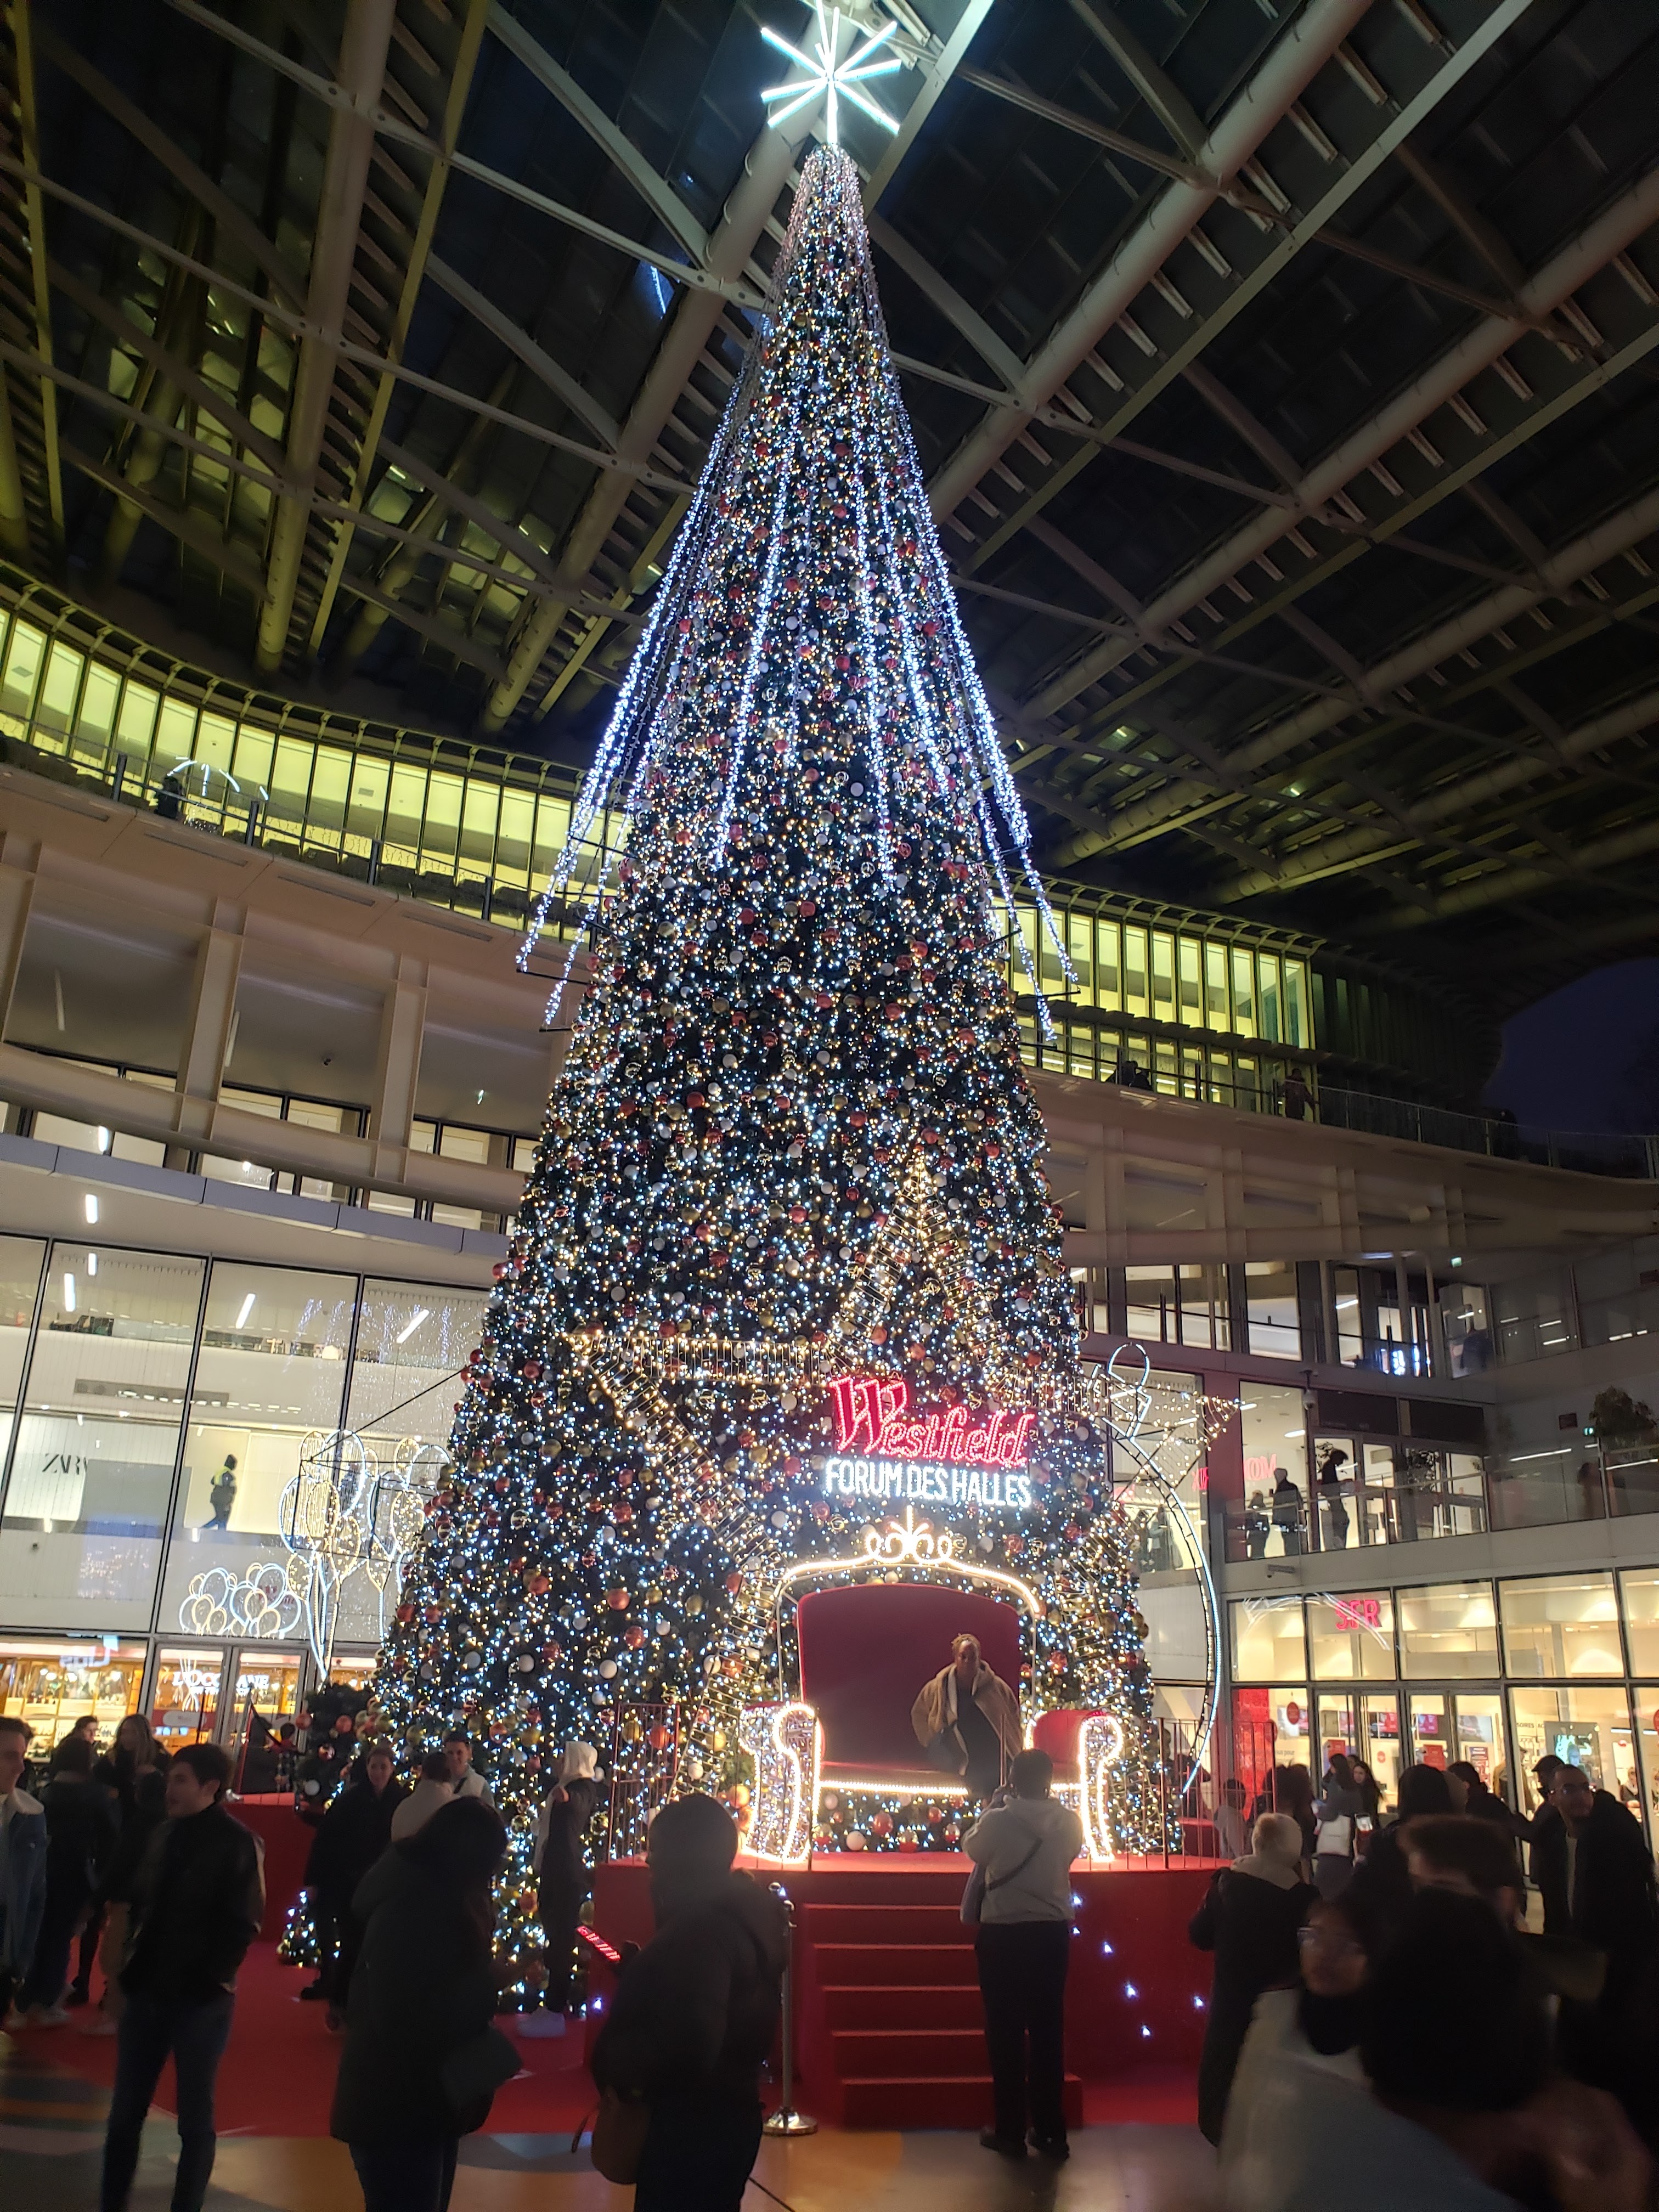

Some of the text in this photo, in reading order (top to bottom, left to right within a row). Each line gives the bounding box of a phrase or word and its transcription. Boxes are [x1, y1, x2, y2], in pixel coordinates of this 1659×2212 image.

[830, 1375, 1036, 1468] Westfield
[826, 1458, 1031, 1509] FORUM DES HALLES
[1335, 1599, 1380, 1630] SFR
